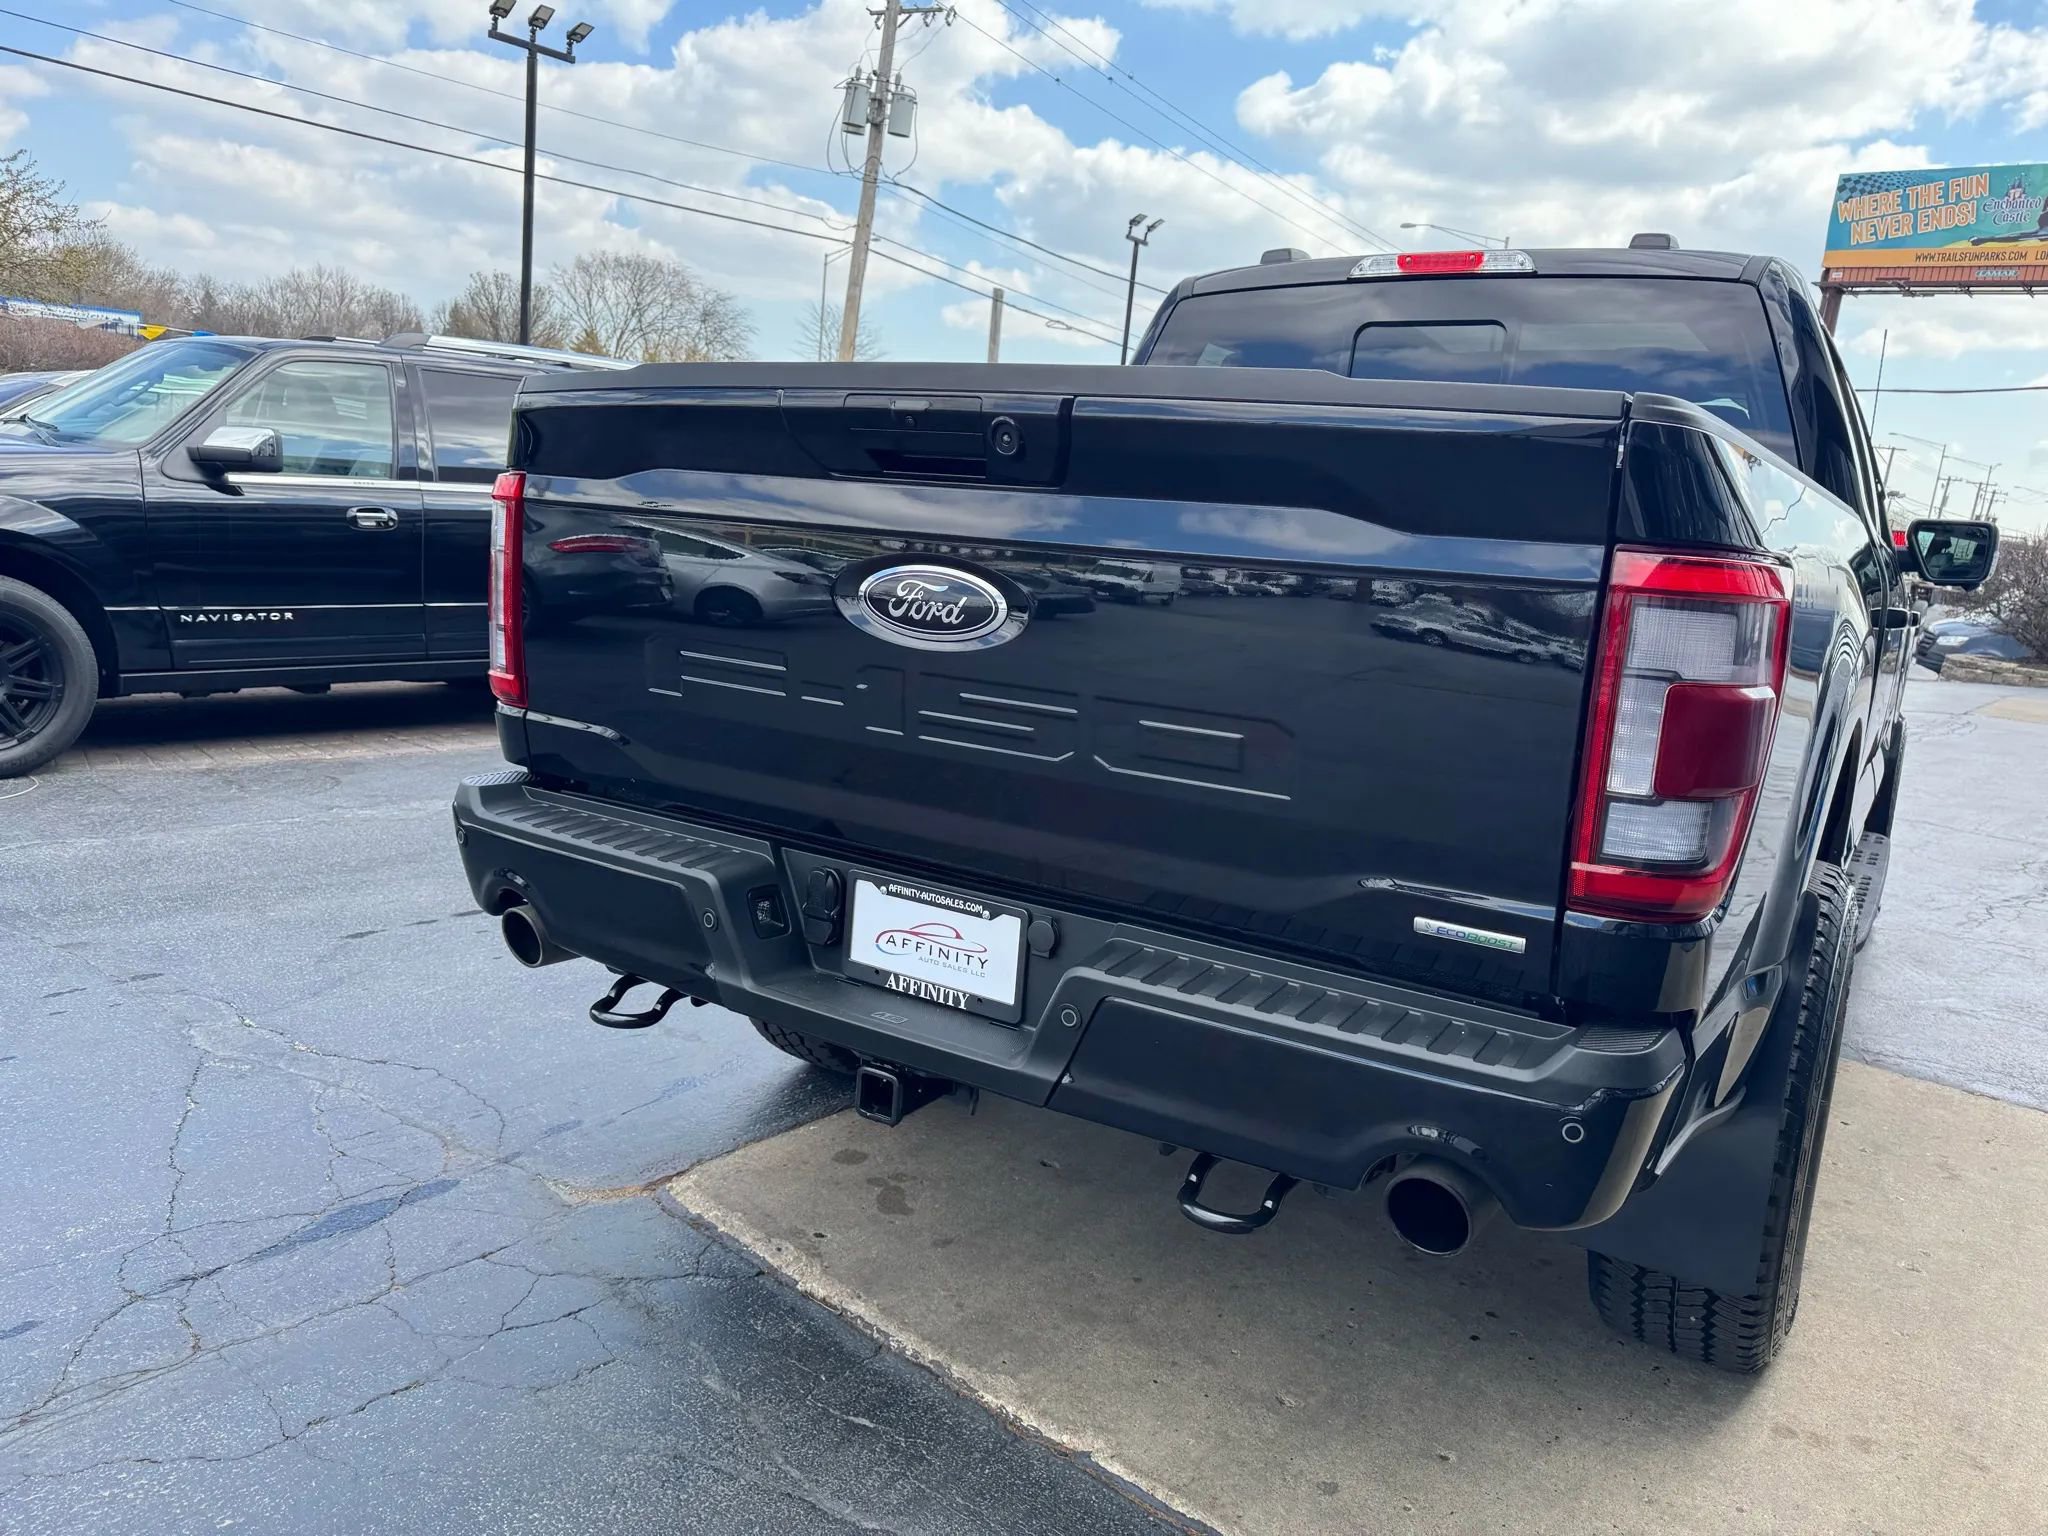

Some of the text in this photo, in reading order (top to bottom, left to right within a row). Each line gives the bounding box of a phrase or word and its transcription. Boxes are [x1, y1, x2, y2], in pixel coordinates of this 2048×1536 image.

[1838, 172, 1989, 223] WHERE THE FUN
[1983, 196, 2042, 212] Enchanted
[1851, 200, 1977, 245] NEVER ENDS!
[1992, 209, 2031, 226] Castle
[1915, 251, 2027, 263] WWW.TRAILSFUNPARKS.COM
[888, 579, 968, 624] Ford
[180, 612, 294, 623] NAVIGATOR
[888, 883, 983, 914] AFFINITY-AUTOSALES.COM
[1437, 926, 1517, 949] ECOBOOST
[886, 934, 989, 969] AFFINITY
[918, 955, 986, 978] AUTO SALES LLC
[884, 972, 970, 1010] AFFINITY
